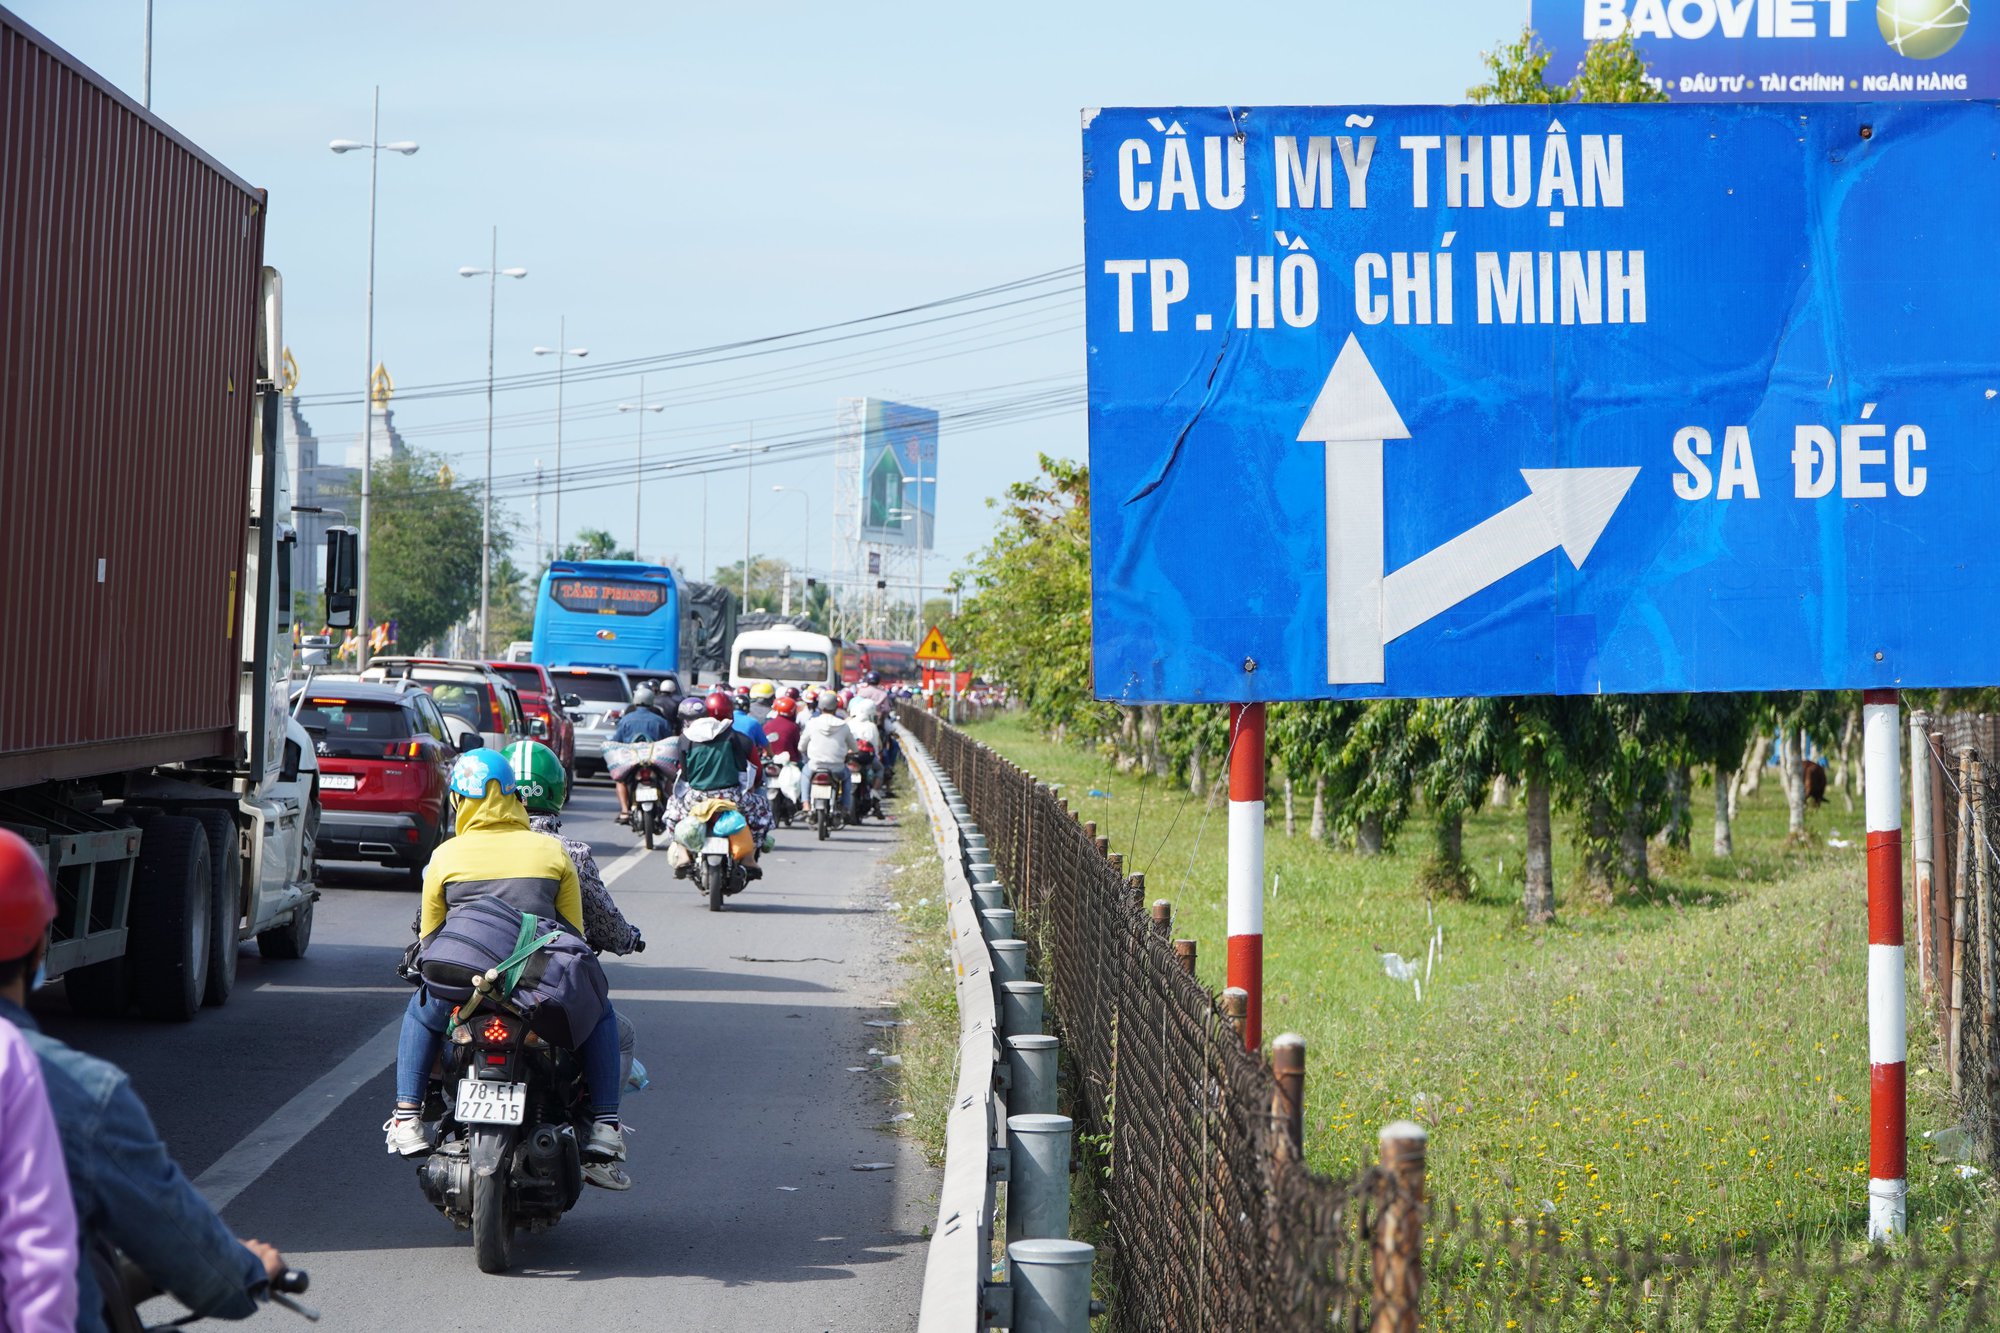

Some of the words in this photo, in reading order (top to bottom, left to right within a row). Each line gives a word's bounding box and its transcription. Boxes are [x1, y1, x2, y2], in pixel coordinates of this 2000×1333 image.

[1719, 74, 1746, 93] TƯ
[1759, 72, 1787, 92] TÀI
[1789, 72, 1845, 92] CHÍNH
[1862, 72, 1914, 92] NGÂN
[1916, 71, 1968, 91] HÀNG
[1118, 116, 1247, 211] CẦU
[1274, 113, 1376, 209] MỸ
[1400, 117, 1625, 228] THUẬN
[1104, 258, 1213, 333] TP.
[1235, 230, 1320, 330] HỒ
[1354, 230, 1454, 326] CHÍ
[1475, 249, 1648, 325] MINH
[1672, 425, 1761, 500] SA
[1791, 402, 1928, 498] ĐÉC
[602, 587, 659, 603] PHONG
[468, 1083, 515, 1102] 78-E1
[459, 1101, 520, 1121] 272.15
